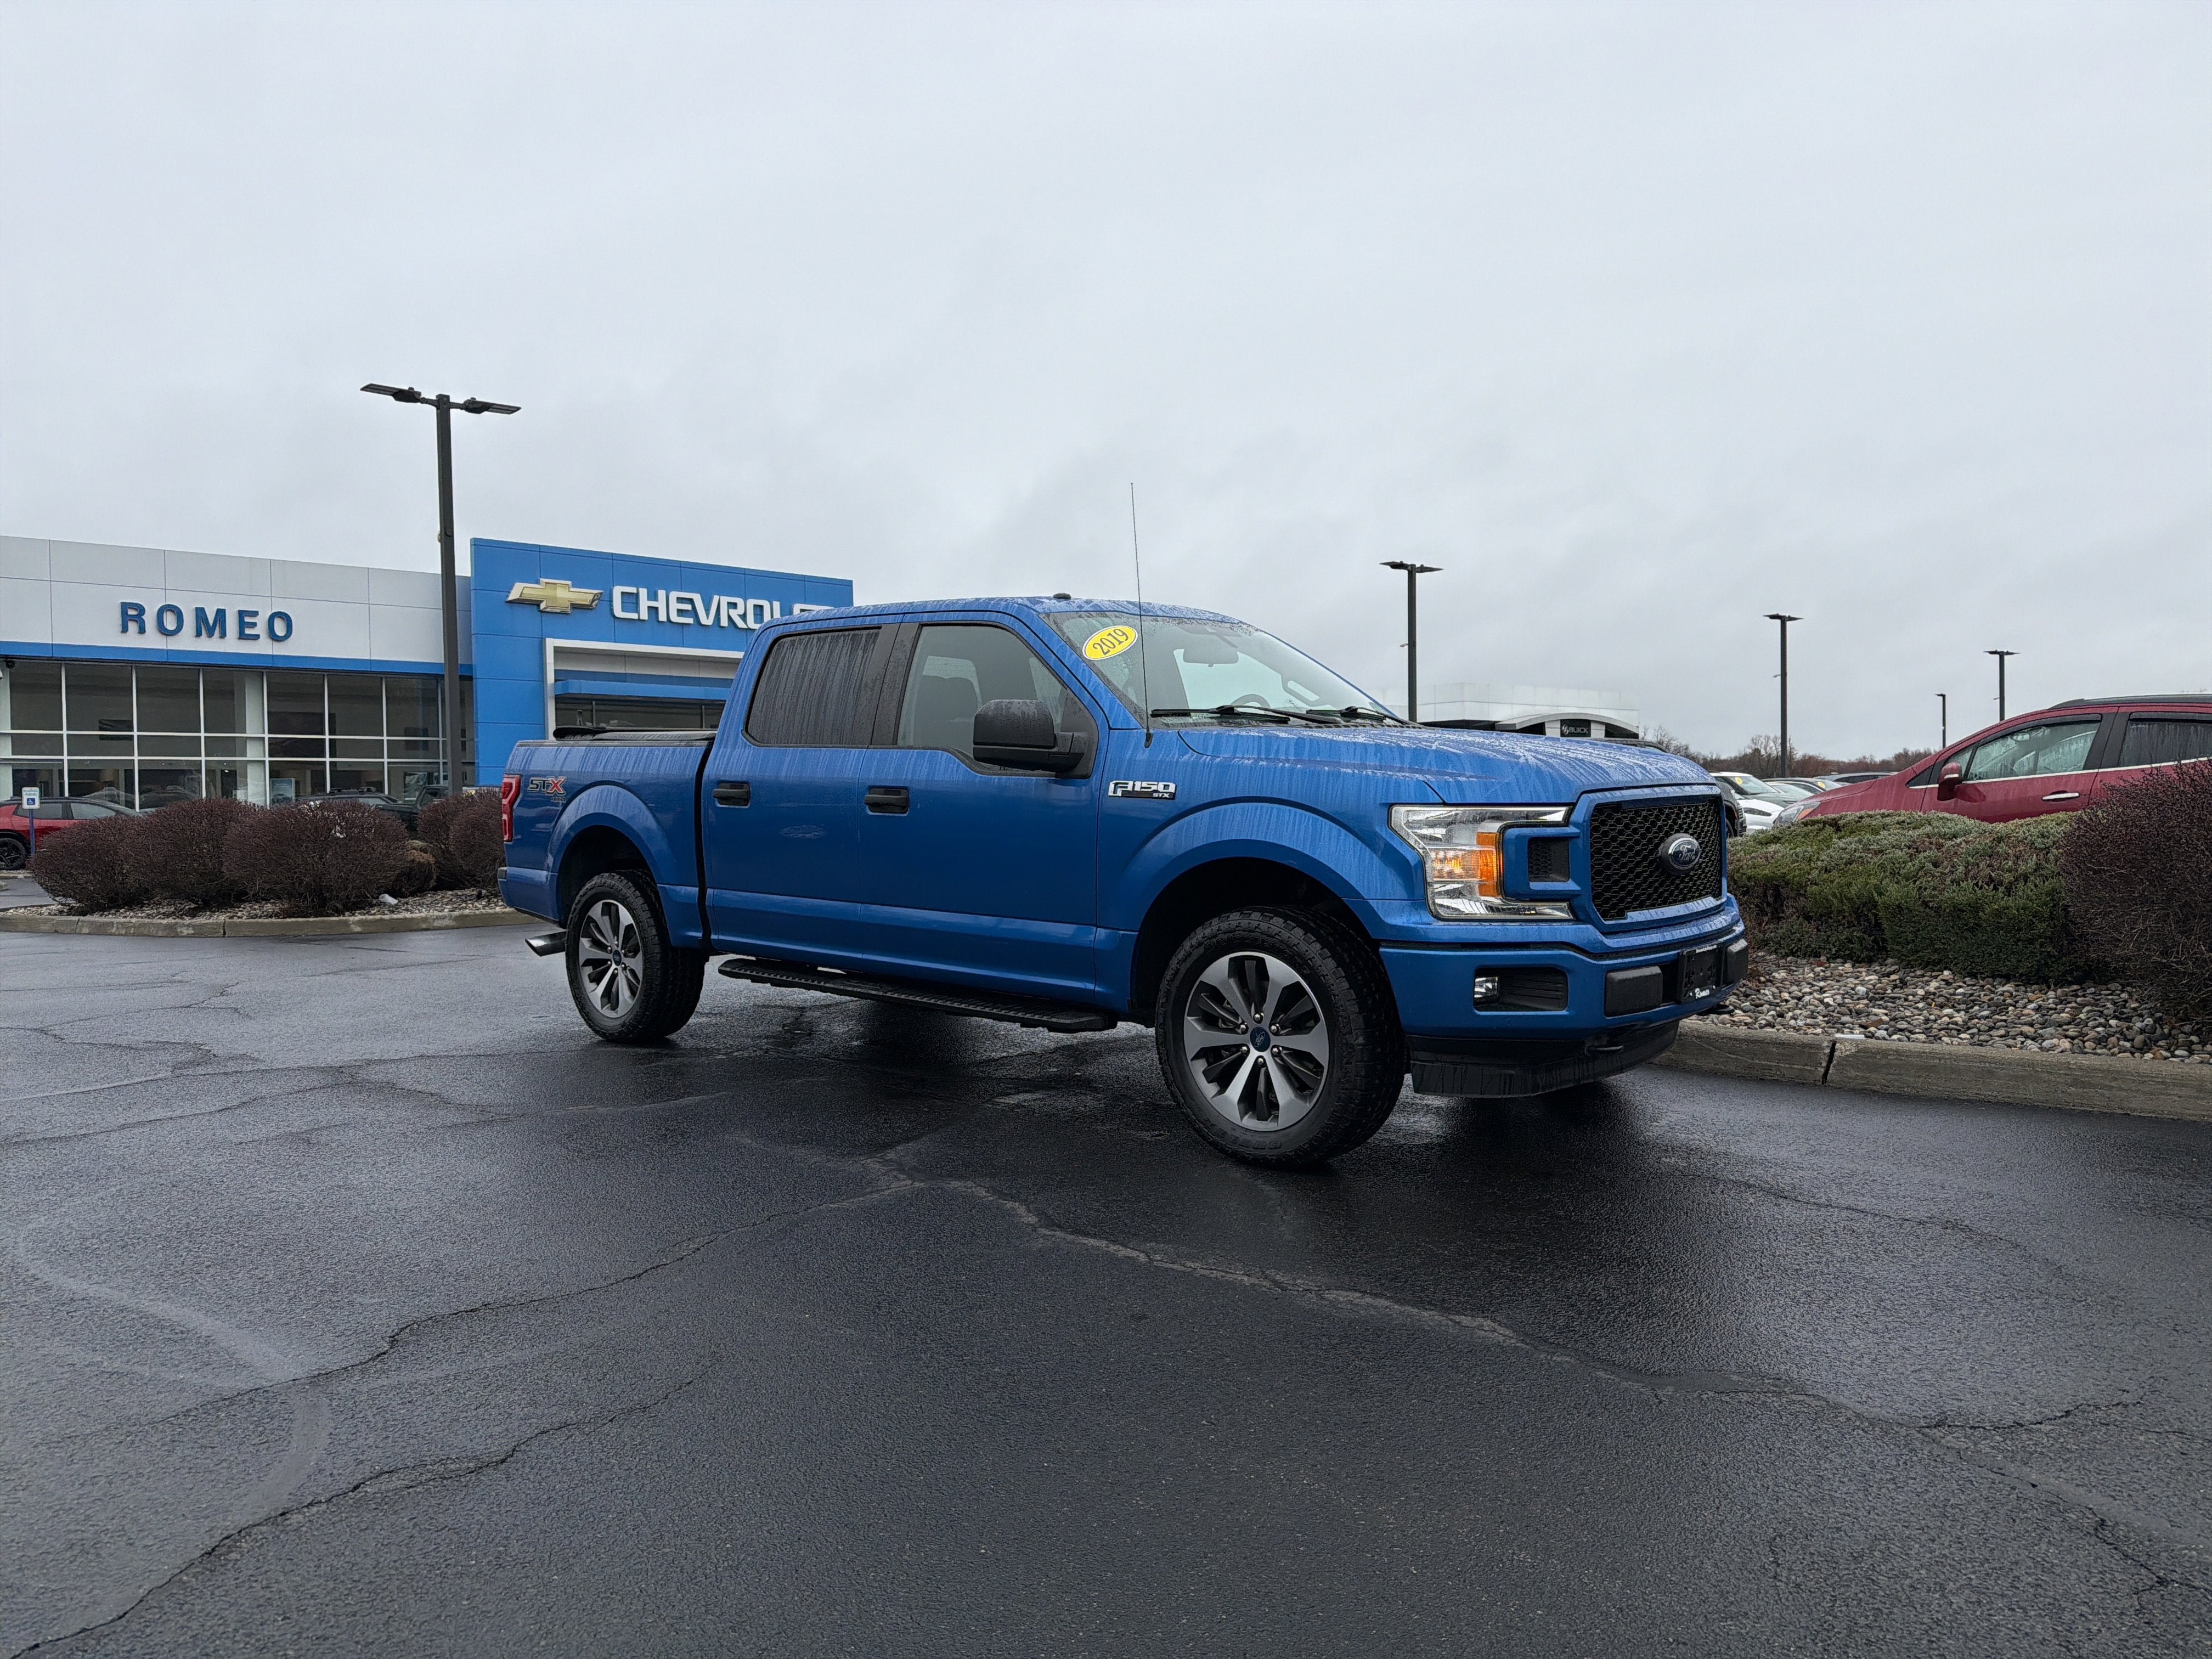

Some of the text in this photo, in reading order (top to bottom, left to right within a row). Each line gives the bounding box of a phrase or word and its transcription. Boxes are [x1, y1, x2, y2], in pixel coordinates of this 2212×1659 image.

[120, 601, 293, 642] ROMEO
[613, 586, 834, 630] CHEVRO
[1092, 629, 1128, 656] 2019
[527, 776, 567, 796] STX
